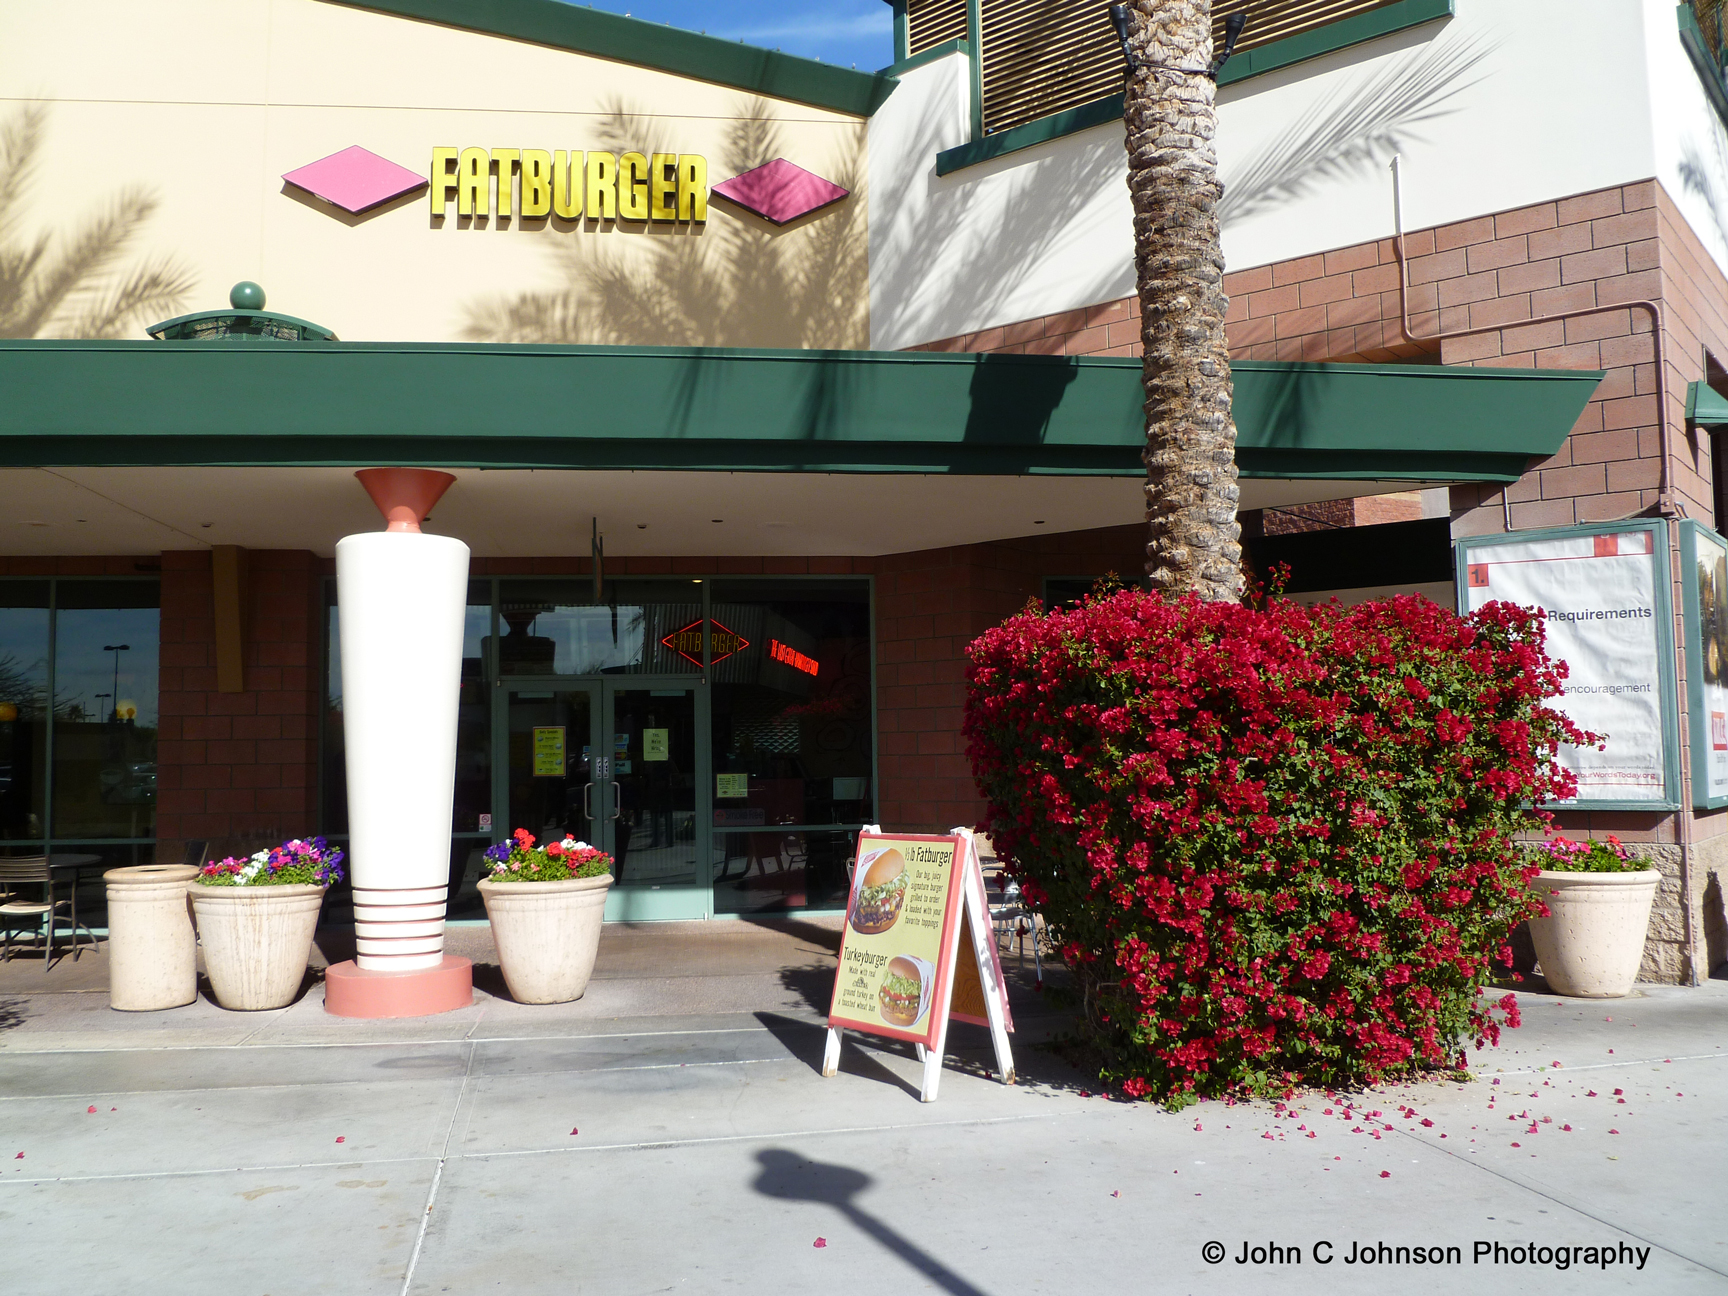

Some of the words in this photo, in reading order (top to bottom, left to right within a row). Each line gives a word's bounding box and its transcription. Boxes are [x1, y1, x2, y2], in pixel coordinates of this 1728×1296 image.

[430, 146, 708, 224] FATBURGER
[1470, 568, 1485, 584] 1.
[1548, 606, 1652, 623] Requirements
[672, 631, 741, 653] FATBRGER
[1564, 682, 1651, 696] encouragement
[916, 846, 953, 867] Fatburger
[911, 882, 929, 891] signature
[930, 883, 943, 893] burger
[844, 946, 888, 969] Turkeyburger
